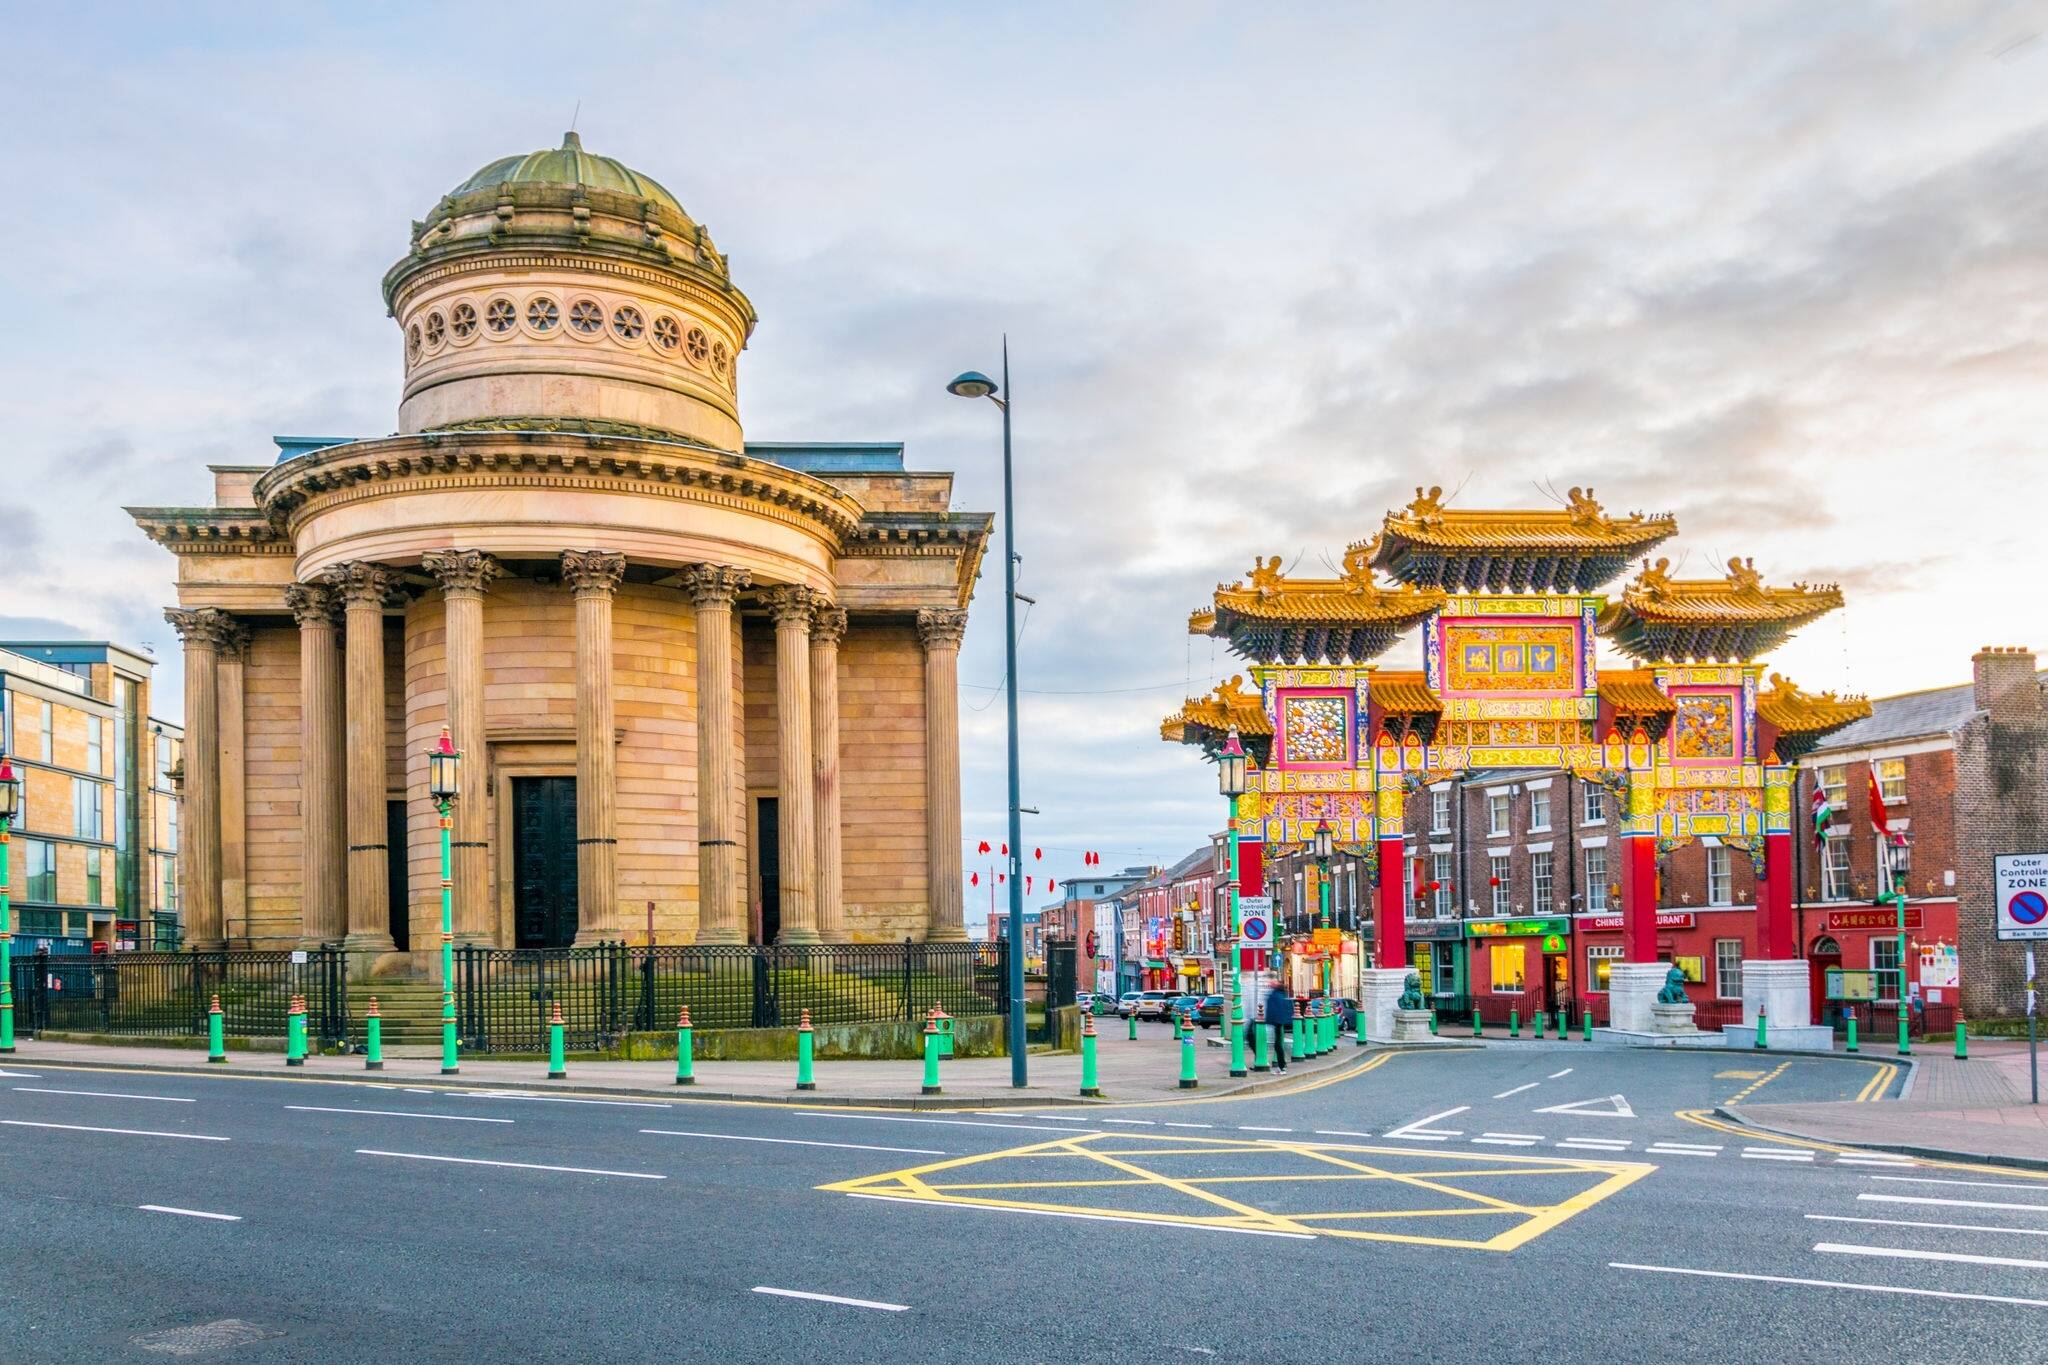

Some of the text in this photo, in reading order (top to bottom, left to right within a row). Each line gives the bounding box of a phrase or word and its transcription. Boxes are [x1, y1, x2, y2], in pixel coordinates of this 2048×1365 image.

[2012, 859, 2041, 867] Outer
[2000, 868, 2048, 877] Controlle
[2008, 878, 2047, 888] ZONE
[1595, 915, 1686, 927] CHINES URANT
